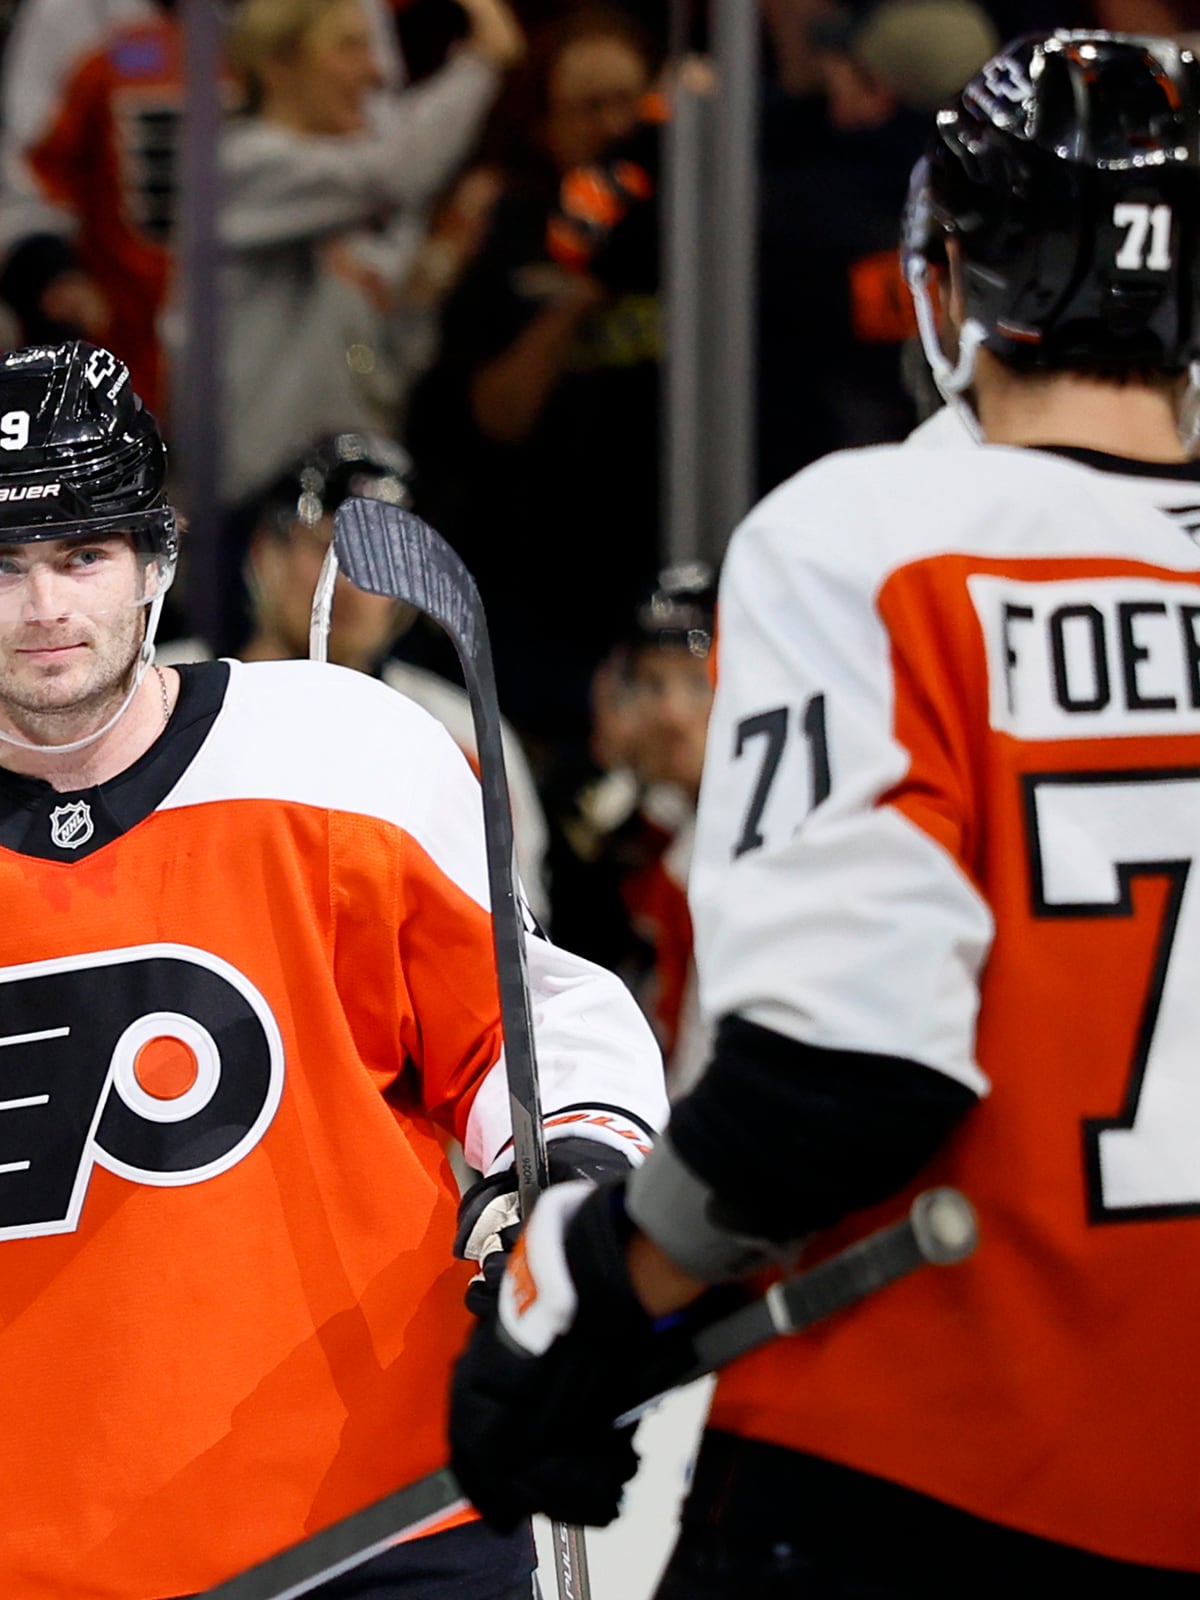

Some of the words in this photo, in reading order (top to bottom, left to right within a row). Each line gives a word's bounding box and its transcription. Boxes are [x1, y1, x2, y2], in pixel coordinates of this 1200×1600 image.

[1113, 203, 1171, 271] 71
[0, 410, 30, 450] 9
[732, 692, 831, 860] 71
